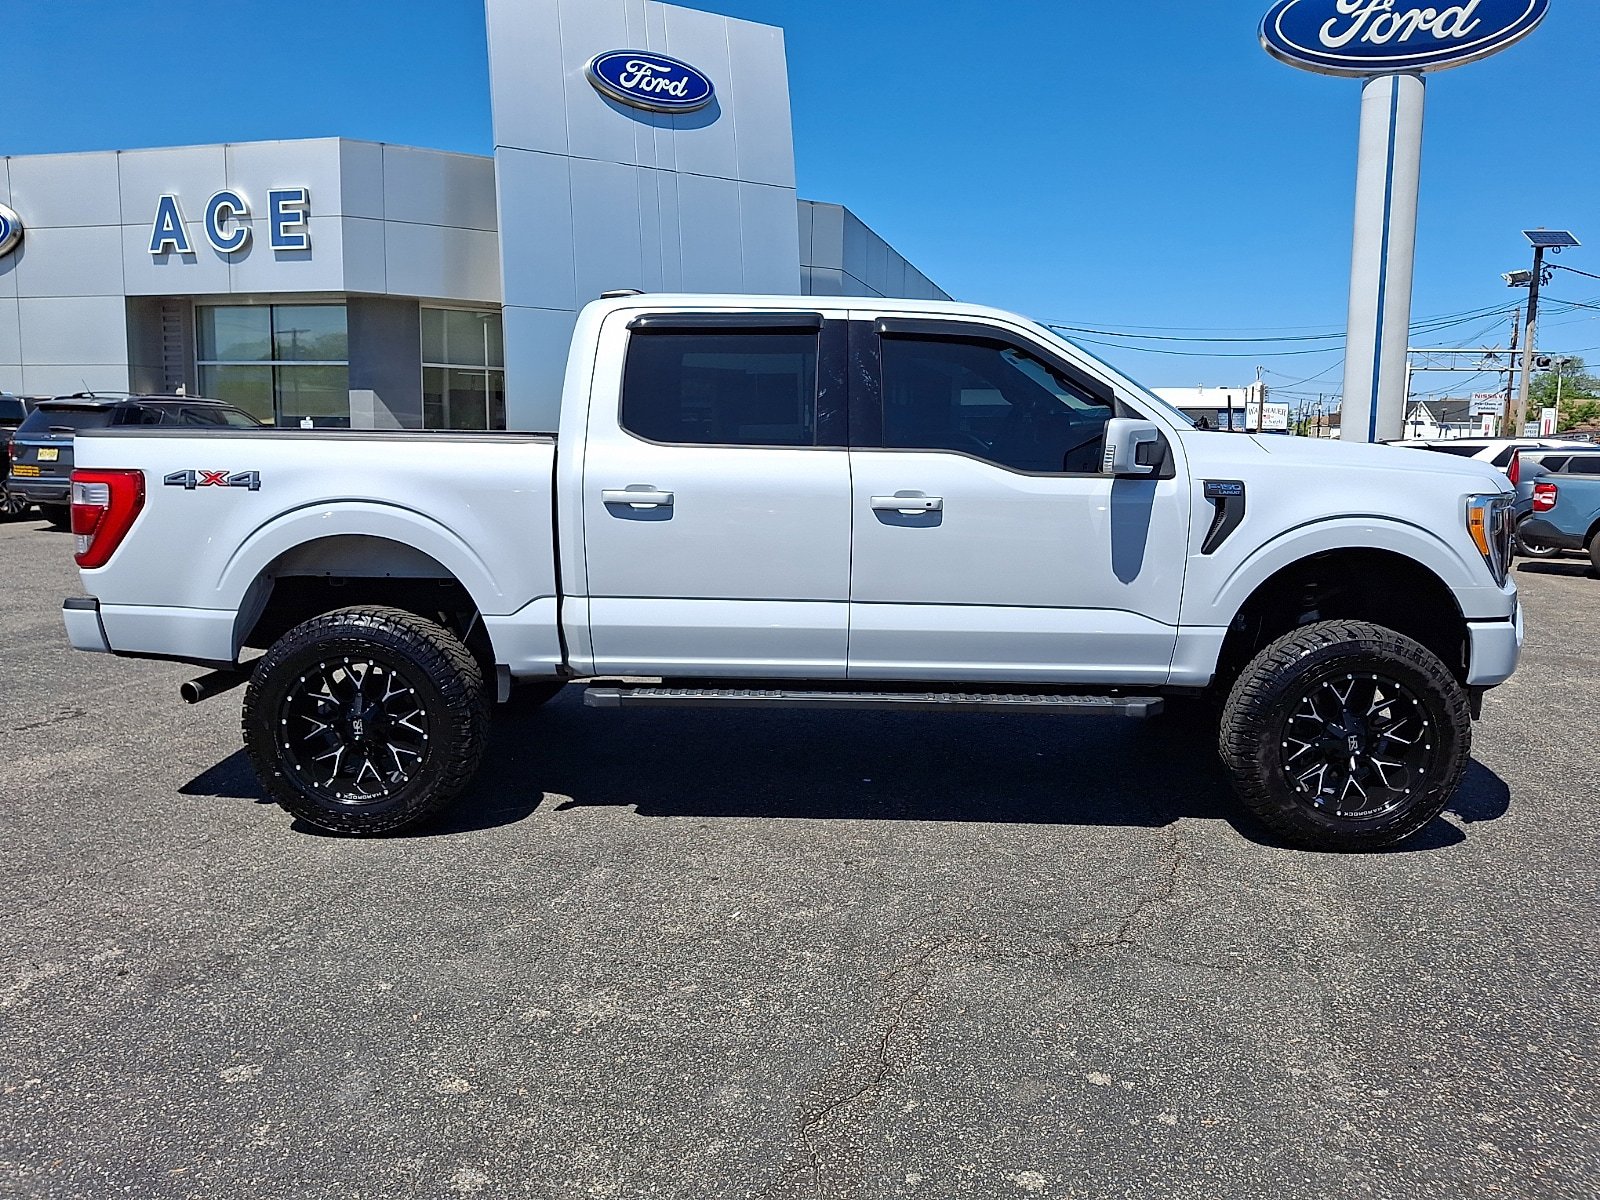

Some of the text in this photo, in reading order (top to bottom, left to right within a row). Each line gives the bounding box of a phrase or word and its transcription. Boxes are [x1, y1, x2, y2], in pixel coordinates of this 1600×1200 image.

[1319, 0, 1480, 48] Ford
[620, 60, 688, 97] Ford
[147, 187, 308, 253] ACE
